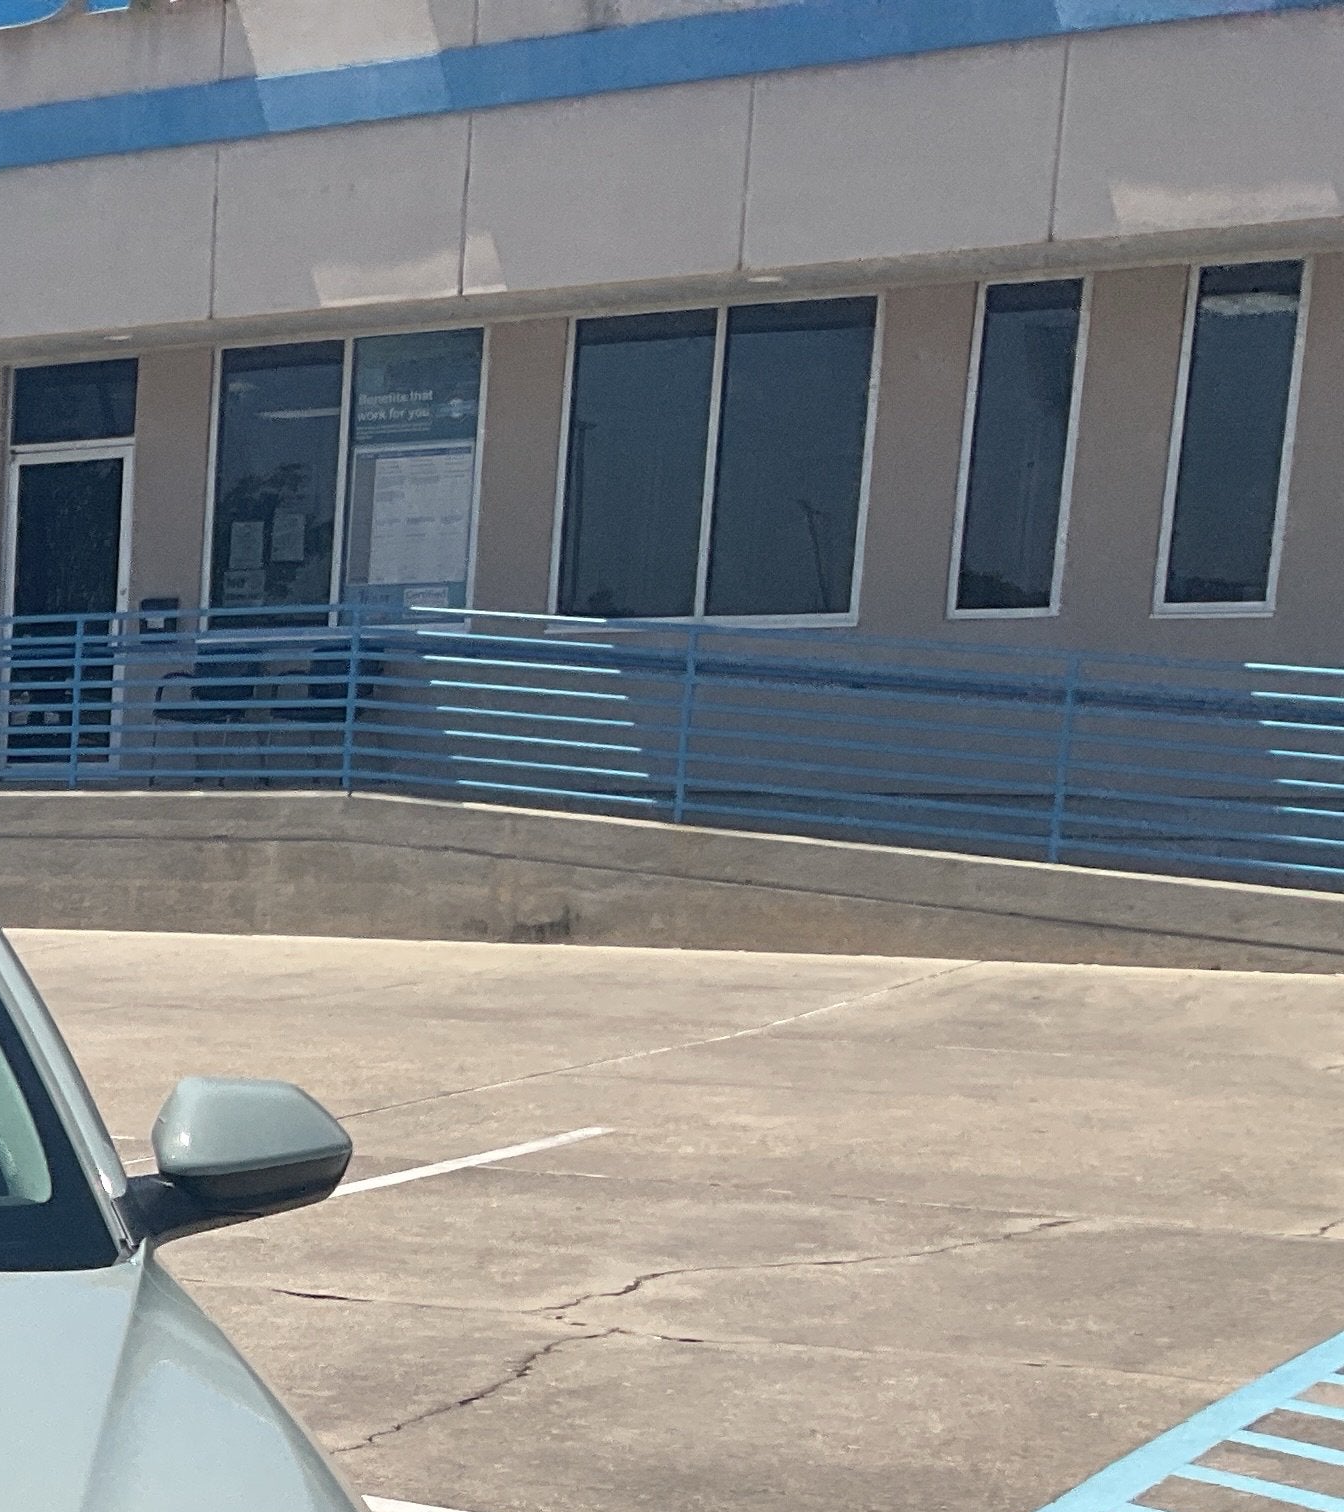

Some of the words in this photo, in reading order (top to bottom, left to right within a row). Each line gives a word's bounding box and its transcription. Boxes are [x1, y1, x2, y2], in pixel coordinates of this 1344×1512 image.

[358, 411, 386, 422] work
[389, 407, 405, 419] for
[407, 408, 430, 421] you
